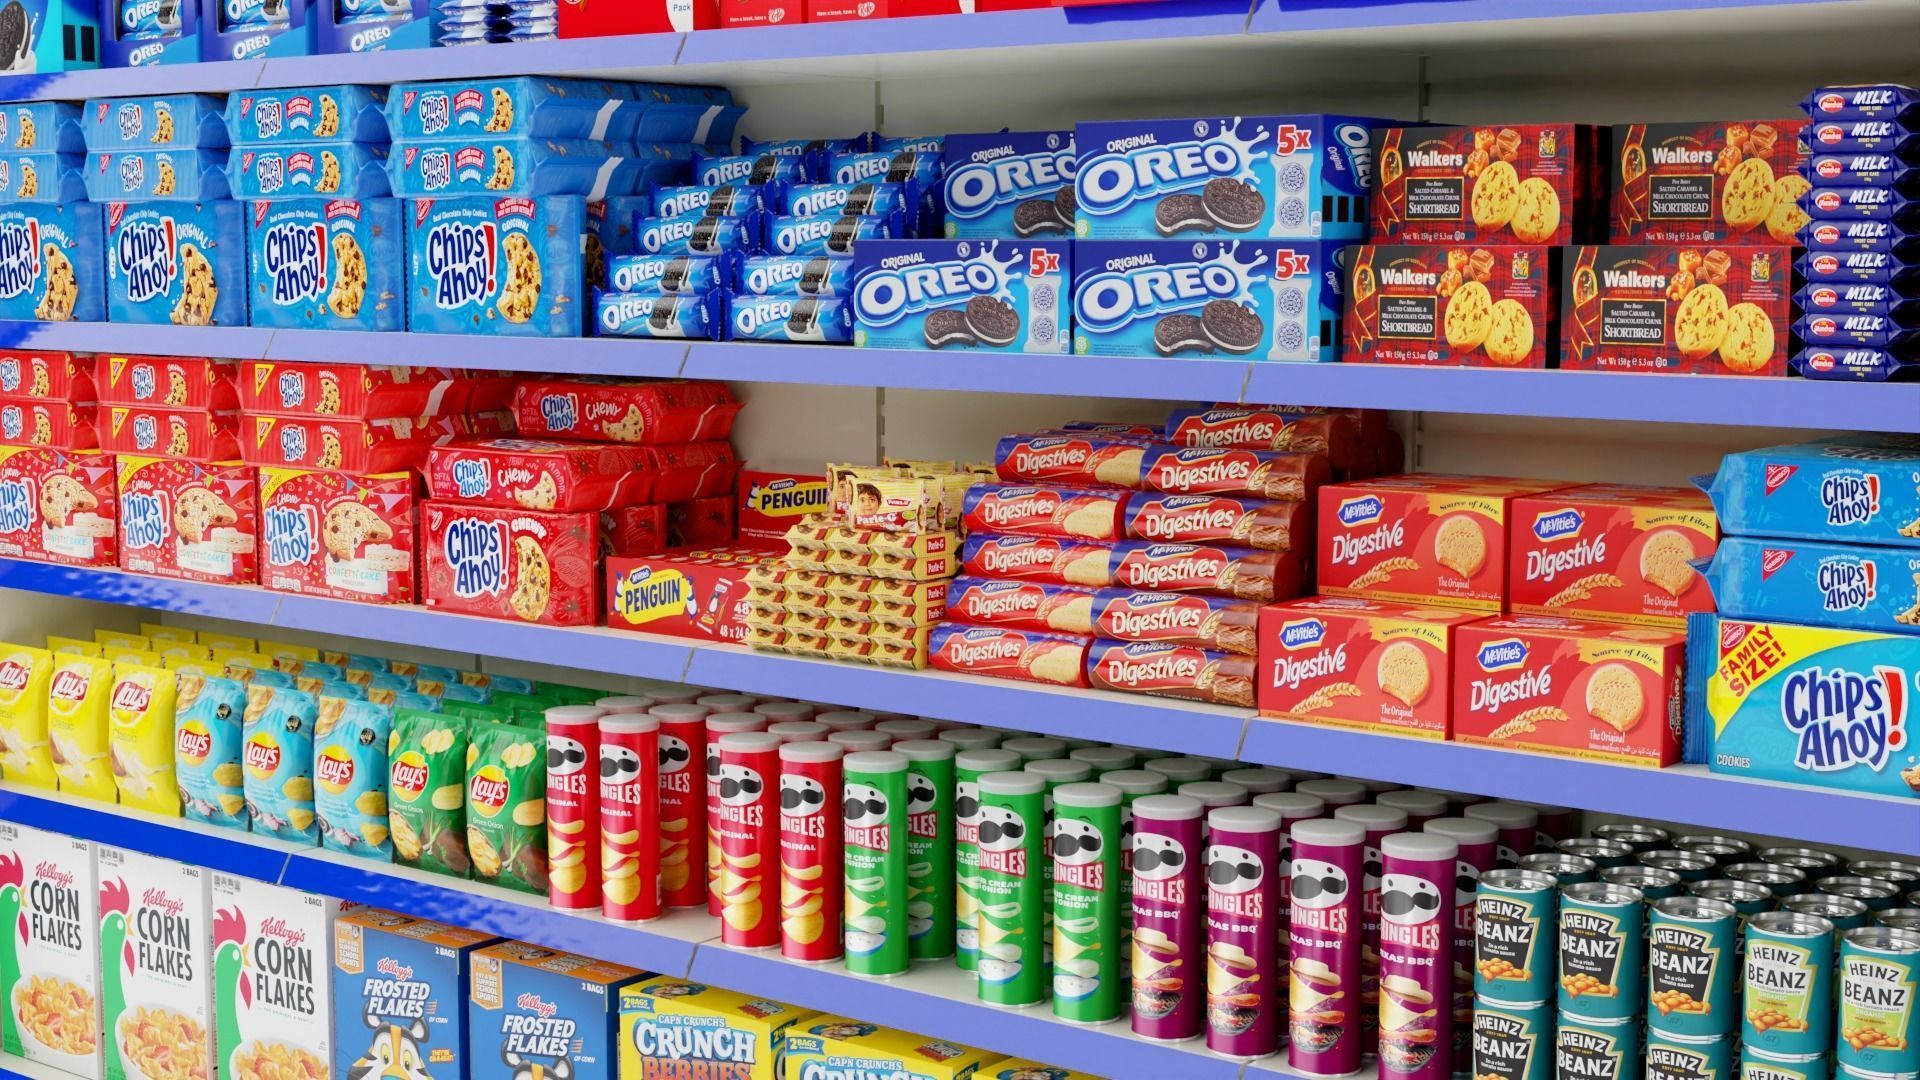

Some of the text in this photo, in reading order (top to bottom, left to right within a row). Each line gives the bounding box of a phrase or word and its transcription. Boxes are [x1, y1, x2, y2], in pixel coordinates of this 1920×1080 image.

[125, 0, 159, 29] OREO
[234, 35, 270, 59] OREO
[351, 26, 391, 52] OREO
[129, 44, 164, 66] OREO
[1852, 90, 1892, 104] MILK
[1107, 134, 1157, 152] ORIGINAL
[1278, 126, 1310, 155] 5x
[422, 154, 444, 176] Chips
[972, 145, 1014, 162] ORIGINAL
[1651, 147, 1712, 164] Walkers
[1850, 156, 1890, 170] MILK
[1082, 147, 1236, 206] OREO
[793, 189, 846, 216] OREO
[1653, 201, 1708, 213] SHORTBREAD
[177, 224, 209, 248] ORIGINAL
[502, 219, 529, 233] ORIGINAL
[644, 222, 693, 252] OREO
[1848, 223, 1887, 237] MILK
[119, 219, 165, 271] Chips
[266, 225, 314, 278] Chips
[429, 225, 485, 279] Chips
[881, 253, 925, 270] ORIGINAL
[1030, 249, 1059, 277] 5x
[1106, 254, 1156, 272] ORIGINAL
[1278, 250, 1310, 279] 5x
[615, 263, 664, 291] OREO
[749, 261, 803, 295] OREO
[1380, 268, 1436, 285] Walkers
[1603, 270, 1665, 288] Walkers
[862, 264, 995, 316] OREO
[1082, 267, 1236, 324] OREO
[1845, 287, 1884, 300] MILK
[603, 299, 652, 331] OREO
[737, 300, 791, 333] OREO
[1381, 320, 1433, 333] SHORTBREAD
[1604, 325, 1661, 338] SHORTBREAD
[1843, 352, 1882, 365] MILK
[454, 461, 484, 484] Chips
[1016, 449, 1085, 472] Digestives
[1161, 461, 1249, 486] Digestives
[1823, 477, 1868, 506] Chips
[857, 513, 897, 525] Parle-G
[1145, 510, 1234, 534] Digestives
[1344, 502, 1376, 520] McVitie's
[266, 510, 306, 542] Chips
[511, 518, 547, 538] CHEWY
[447, 520, 498, 565] Chips
[1332, 518, 1405, 565] Digestive
[1526, 533, 1606, 582] Digestive
[1129, 560, 1220, 585] Digestives
[1438, 577, 1469, 589] The Original
[1820, 564, 1865, 591] Chips
[625, 580, 681, 616] PENGUIN
[734, 602, 751, 614] 48
[720, 625, 728, 637] 48
[1111, 608, 1200, 634] Digestives
[1286, 625, 1318, 643] McVitie's
[1274, 642, 1347, 689] Digestive
[1720, 625, 1773, 683] FAMILY
[1730, 641, 1787, 697] SIZE!
[52, 673, 86, 701] Lay's
[113, 683, 149, 714] Lay's
[1471, 665, 1551, 713] Digestive
[1785, 669, 1883, 729] Chips
[1381, 704, 1413, 718] The Original
[245, 745, 280, 769] Lay's
[1717, 754, 1750, 768] COOKIES
[318, 759, 354, 783] Lay's
[472, 780, 509, 806] Lay's
[35, 861, 73, 888] Kellogg's
[30, 880, 79, 922] CORN
[309, 897, 322, 908] BAGS
[1481, 900, 1522, 917] HEINZ
[32, 913, 82, 952] FLAKES
[260, 916, 306, 943] Kellogg's
[1477, 918, 1530, 943] BEANZ
[1657, 929, 1703, 949] HEINZ
[254, 937, 312, 984] CORN
[1652, 948, 1710, 975] BEANZ
[1753, 947, 1800, 965] HEINZ
[1748, 963, 1806, 989] BEANZ
[1850, 963, 1899, 982] HEINZ
[256, 972, 314, 1016] FLAKES
[587, 984, 604, 995] BAGS
[1845, 980, 1905, 1006] BEANZ
[517, 993, 557, 1015] Kellogg's
[624, 998, 648, 1009] 2 BAGS
[502, 1015, 575, 1039] FROSTED
[506, 1033, 568, 1057] FLAKES
[636, 1022, 756, 1064] CRUNCH
[789, 1039, 799, 1051] 2
[643, 1056, 752, 1080] BERRIES
